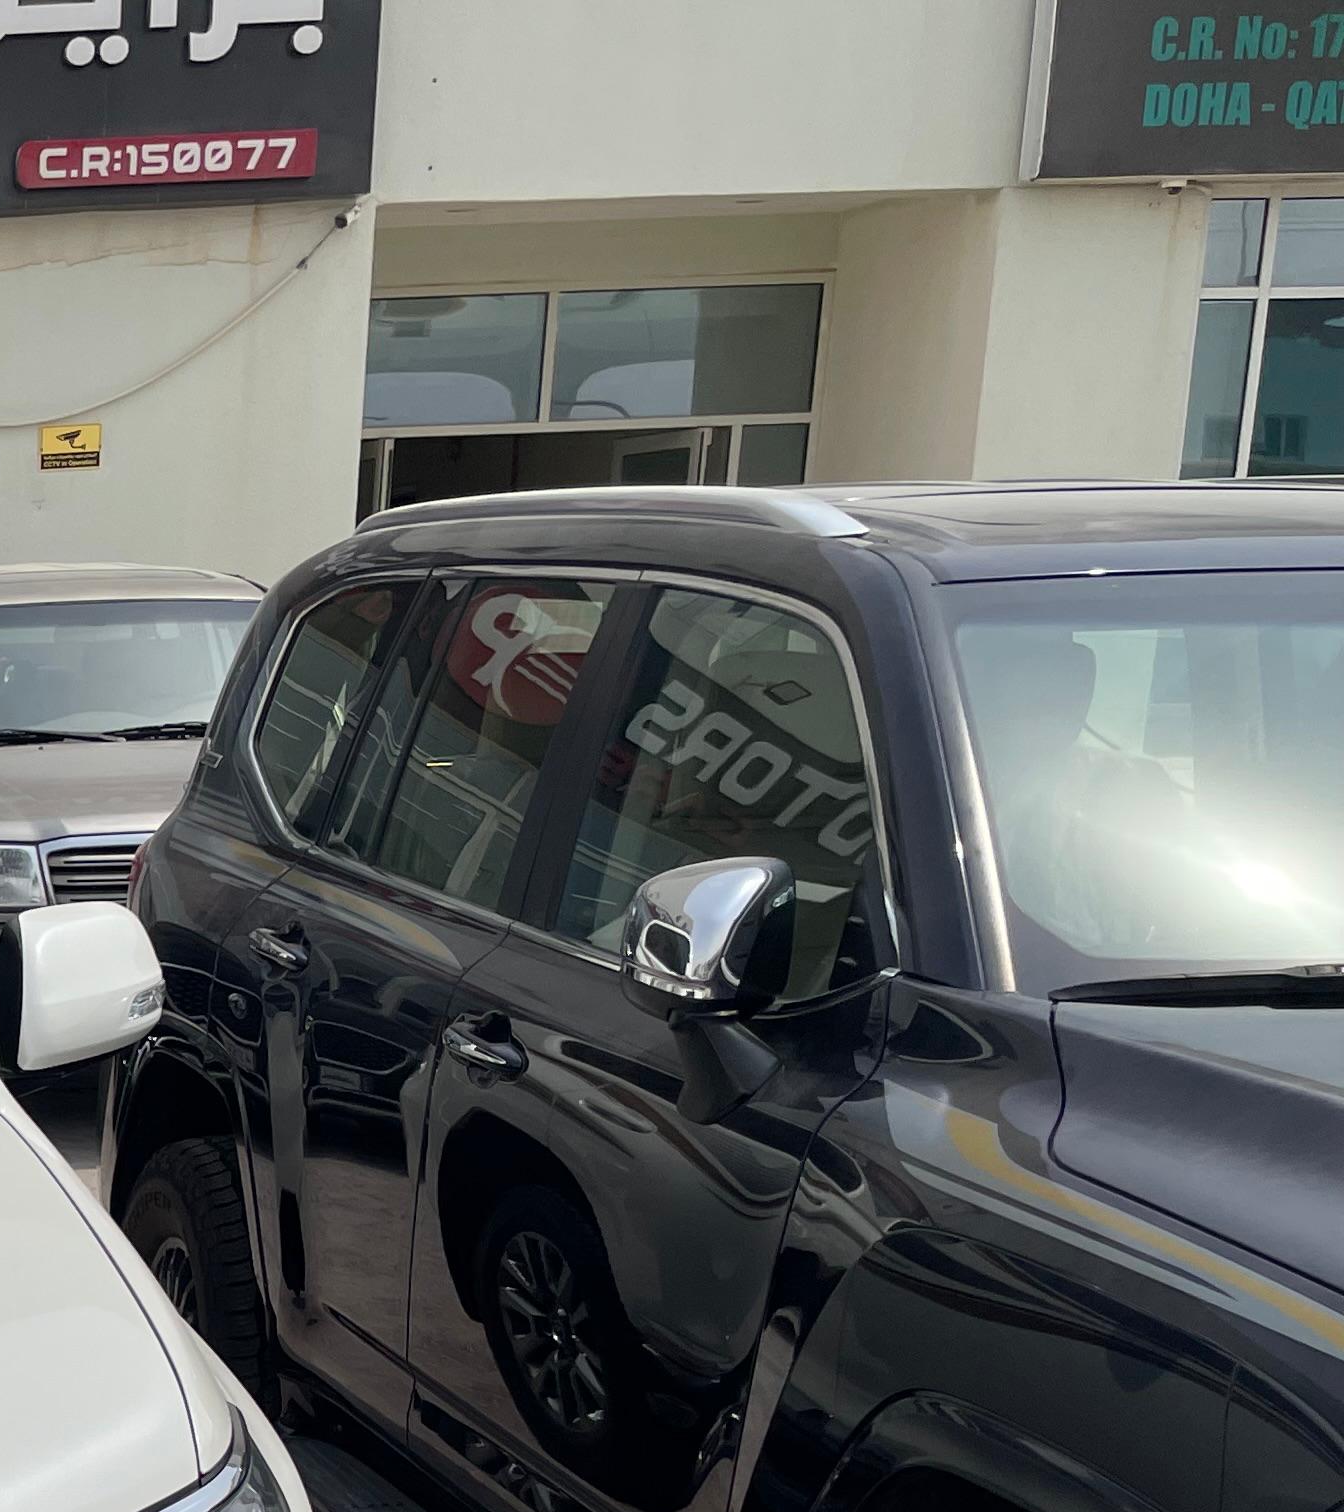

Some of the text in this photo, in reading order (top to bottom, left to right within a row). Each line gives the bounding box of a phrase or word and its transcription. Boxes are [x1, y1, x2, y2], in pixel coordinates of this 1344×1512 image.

[1150, 14, 1223, 63] C.R.
[1233, 14, 1299, 61] No:
[1142, 82, 1251, 128] DOHA
